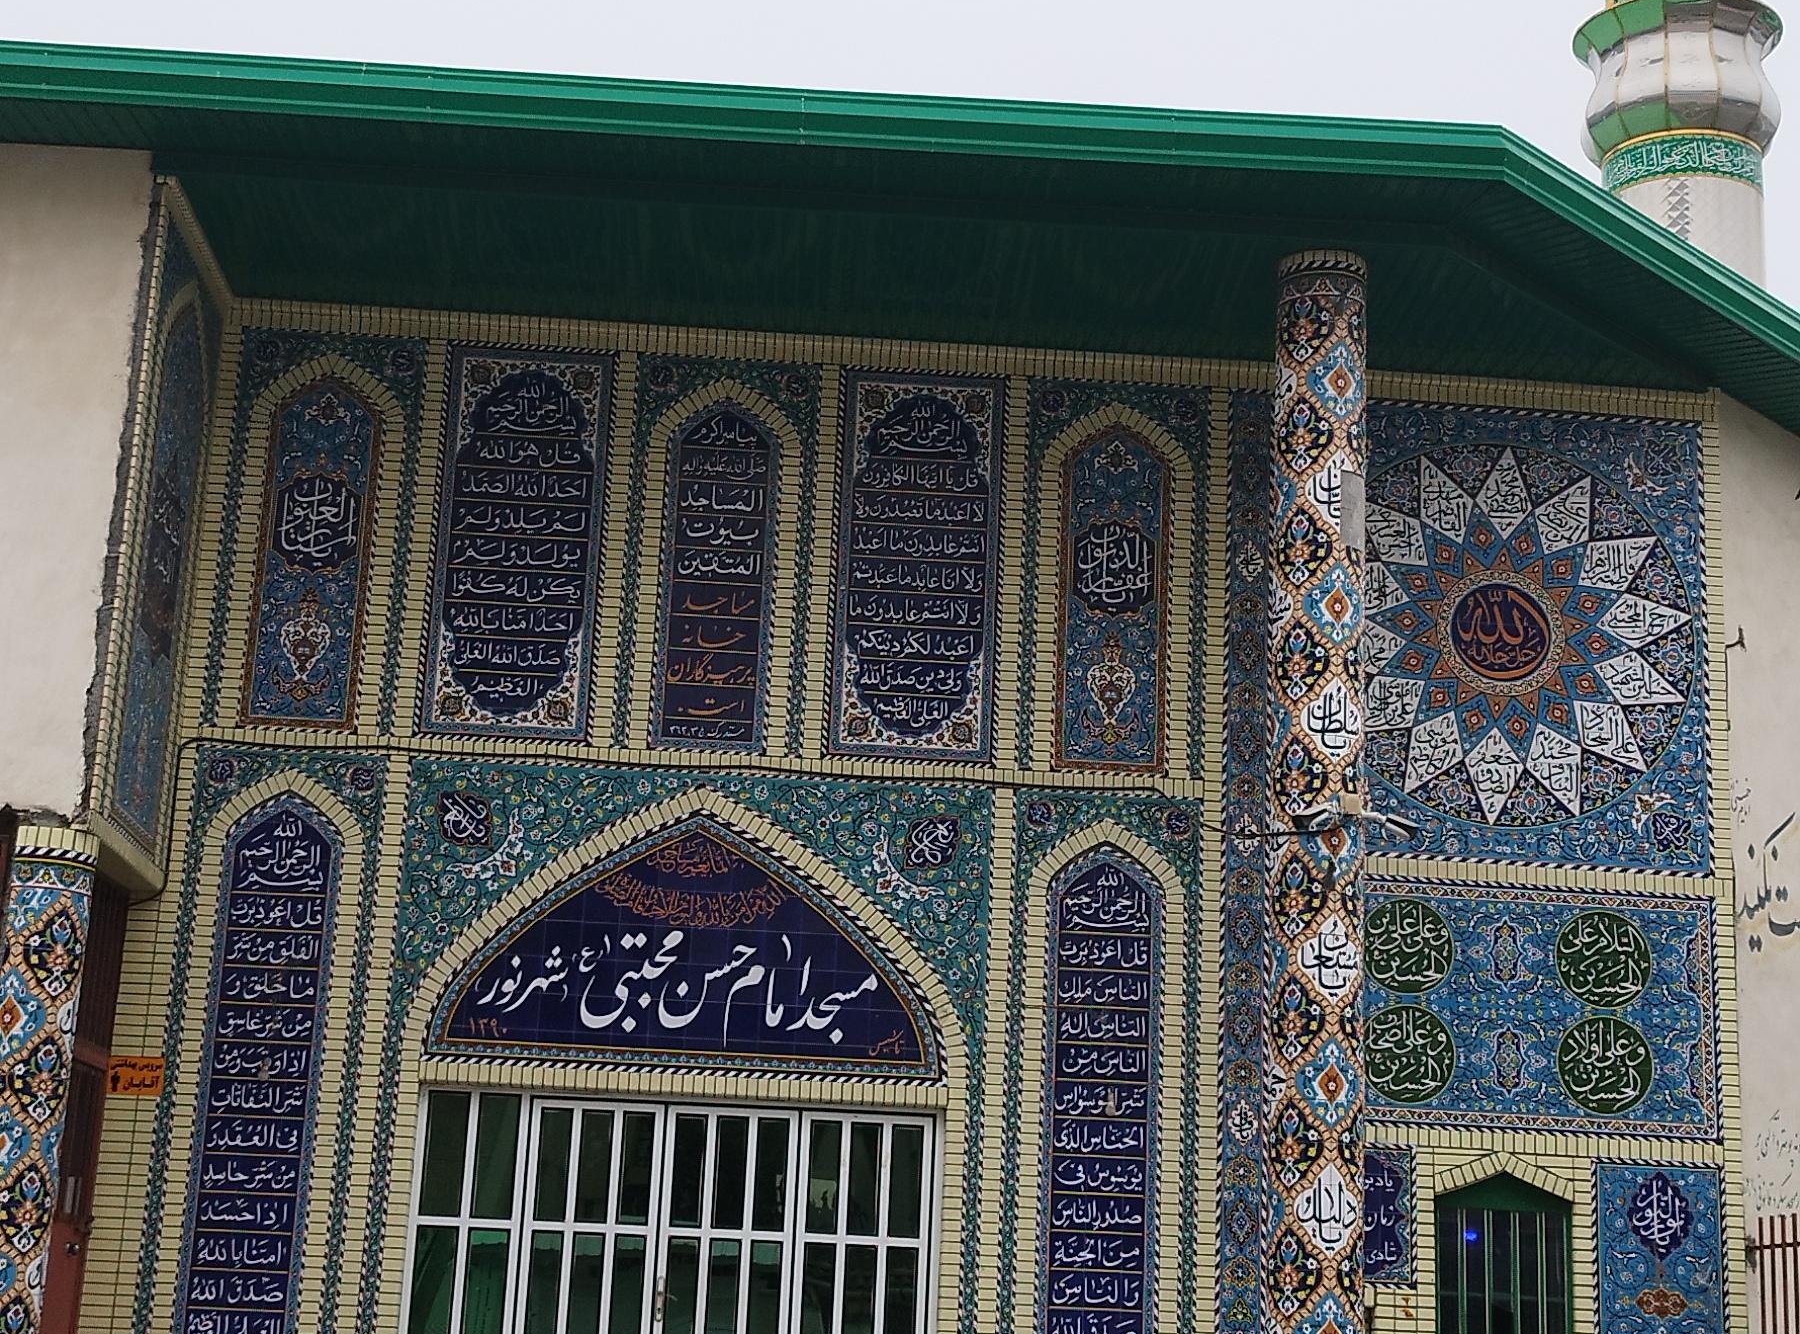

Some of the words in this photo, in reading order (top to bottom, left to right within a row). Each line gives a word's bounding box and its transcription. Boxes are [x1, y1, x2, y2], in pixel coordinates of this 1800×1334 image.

[539, 442, 580, 467] قل
[274, 814, 302, 836] الله
[236, 868, 323, 891] بسم
[1097, 867, 1124, 886] الله
[291, 899, 322, 928] قل
[1066, 913, 1150, 933] بسم
[1121, 940, 1148, 967] قل
[579, 929, 685, 1033] مجتبی
[658, 942, 758, 1030] حسن
[723, 933, 809, 1049] امام
[1094, 975, 1147, 1003] الناس
[785, 968, 879, 1045] مسجد
